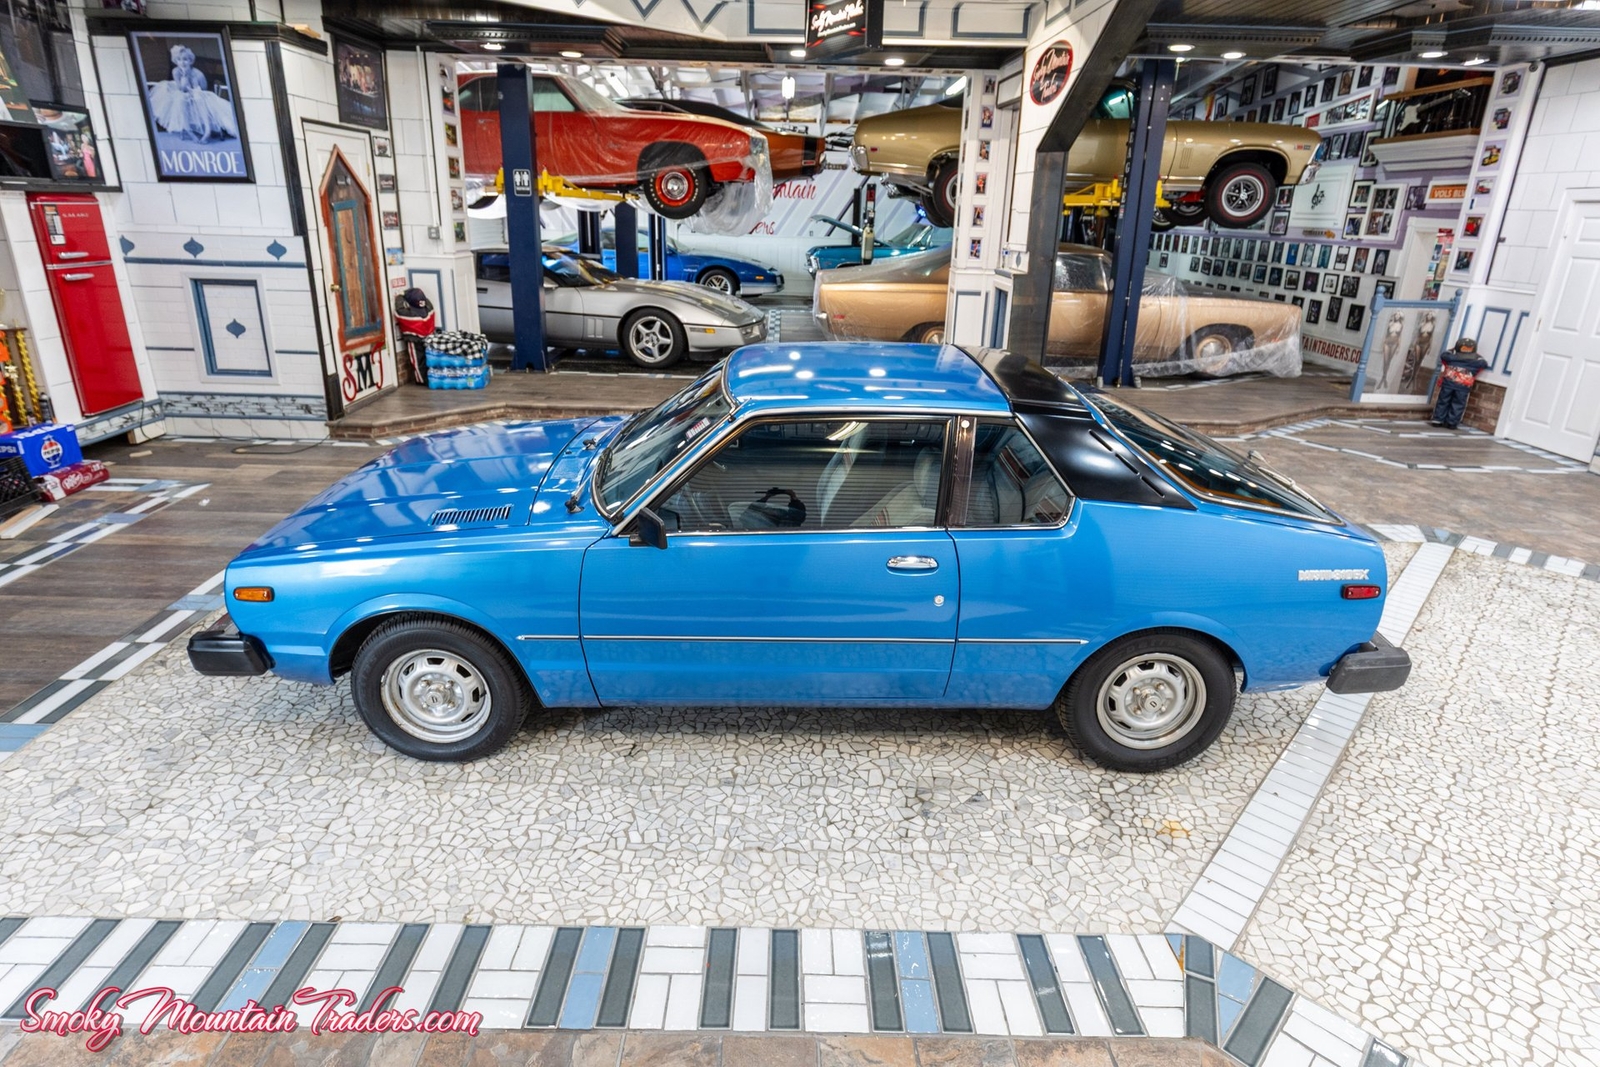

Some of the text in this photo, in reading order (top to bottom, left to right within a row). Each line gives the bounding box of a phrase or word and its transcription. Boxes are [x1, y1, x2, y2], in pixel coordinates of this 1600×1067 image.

[161, 150, 244, 176] MONROE
[1434, 189, 1452, 198] VOLS
[755, 221, 775, 235] ers
[1302, 335, 1362, 364] TAINTRADERS.CO
[43, 447, 60, 456] PEPSI
